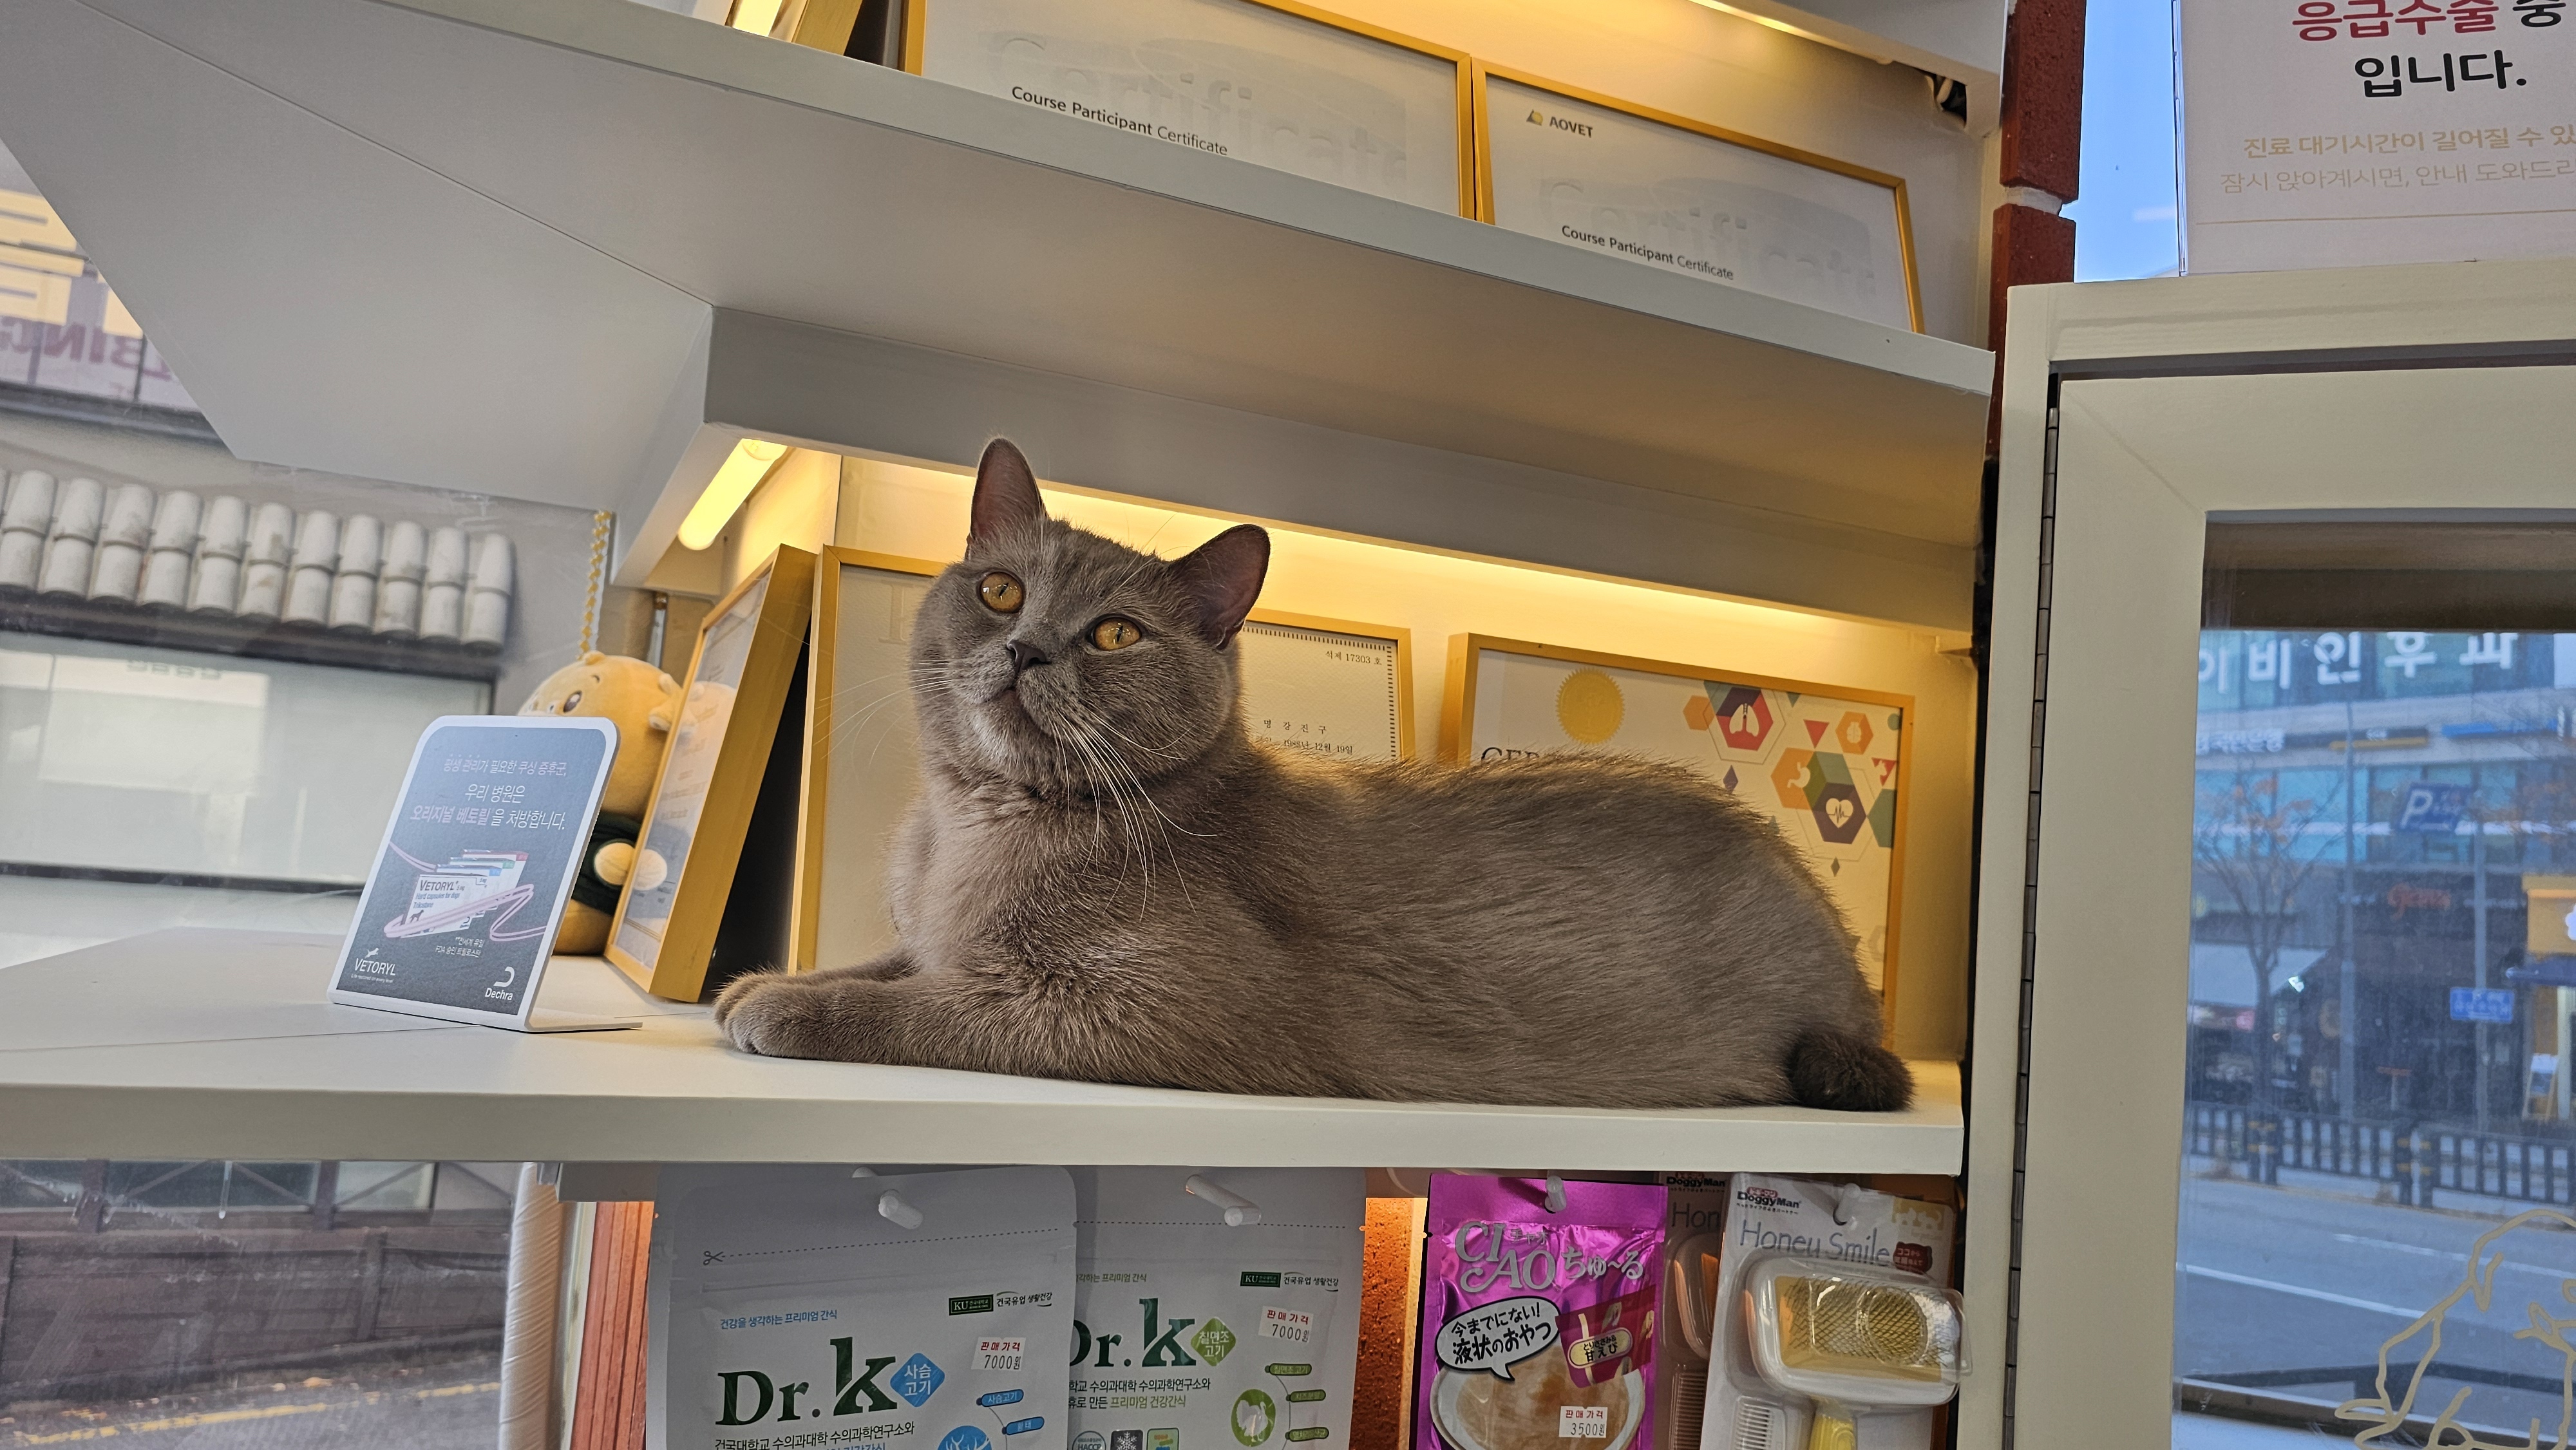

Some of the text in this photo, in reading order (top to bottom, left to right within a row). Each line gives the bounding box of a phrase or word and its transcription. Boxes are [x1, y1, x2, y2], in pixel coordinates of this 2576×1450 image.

[2292, 0, 2499, 41] 응급수술
[2354, 50, 2527, 99] 입니다.
[1012, 85, 1227, 156] Course Participant Certificate
[1549, 115, 1593, 138] AOVET
[2243, 135, 2293, 160] 진료
[2298, 130, 2426, 156] 대기시간이
[2431, 126, 2510, 152] 길어질
[2517, 127, 2545, 147] 수
[2220, 171, 2269, 194] 잠시
[2277, 165, 2410, 191] 앉아계시면,
[2416, 164, 2467, 187] 안내
[1561, 225, 1734, 281] Course Participant Certificate
[1345, 653, 1371, 664] 17303
[1374, 657, 1383, 666] 호
[1314, 742, 1331, 753] 12월
[1336, 744, 1353, 755] 19일
[489, 760, 516, 774] 필요한
[518, 760, 538, 775] 쿠싱
[465, 784, 526, 804] 우리 병원은
[410, 805, 455, 824] 오리지널
[491, 808, 504, 827] 을
[506, 809, 566, 831] 처방합니다.
[2400, 789, 2433, 829] P
[419, 880, 455, 891] VETORYL
[354, 957, 396, 976] VETORYL
[484, 987, 513, 1001] Dechra
[1667, 1176, 1725, 1188] DoggyMan
[1737, 1191, 1800, 1209] DoggyMan
[1510, 1227, 1548, 1245] チャオ
[1740, 1219, 1820, 1258] Honey
[1829, 1227, 1891, 1266] Smile
[1076, 1272, 1147, 1283] 각하는 프리미엄 간식
[1283, 1277, 1311, 1285] 건국유업
[1313, 1277, 1339, 1286] 생활건강
[953, 1301, 969, 1311] KU
[996, 1295, 1026, 1308] 건국유업
[1027, 1292, 1053, 1303] 생활건강
[720, 1309, 837, 1330] 건강을 생각하는 프리미엄 간식
[1451, 1302, 1541, 1337] 今までにない!
[1199, 1331, 1229, 1345] 칠면조
[1453, 1321, 1551, 1365] 液状のおやつ
[1204, 1345, 1225, 1359] 고기
[1585, 1342, 1618, 1362] 甘えび
[904, 1363, 932, 1380] 사슴
[904, 1380, 932, 1397] 고기
[1089, 1379, 1137, 1393] 수의과대학
[1139, 1377, 1211, 1392] 수의과학연구소와
[988, 1391, 1018, 1404] 사슴고기
[1089, 1396, 1108, 1409] 만든
[1150, 1395, 1186, 1409] 건강간식
[772, 1431, 829, 1449] 수의과대학
[830, 1421, 915, 1444] 수의과학연구소와
